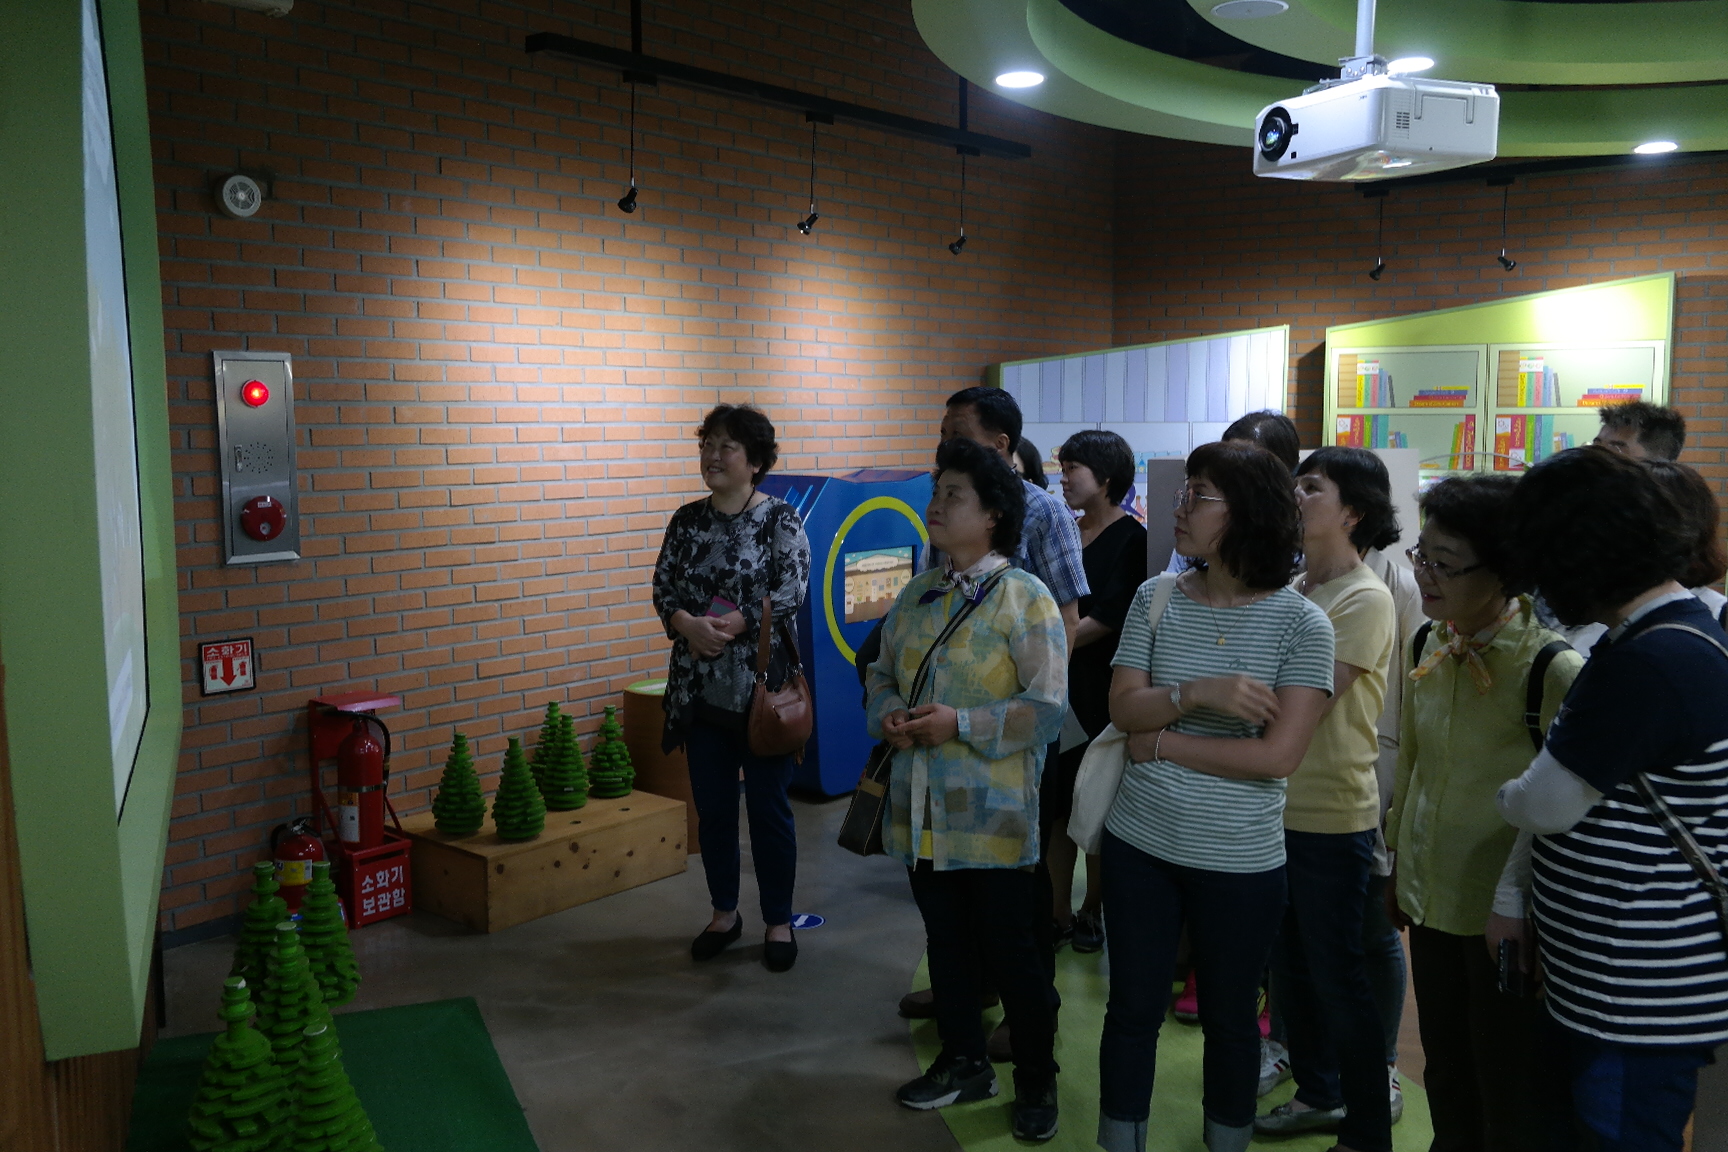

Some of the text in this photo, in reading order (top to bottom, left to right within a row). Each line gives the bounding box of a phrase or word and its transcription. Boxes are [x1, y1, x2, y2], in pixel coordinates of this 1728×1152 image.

[206, 643, 248, 657] 소화기
[361, 865, 404, 894] 소화기
[363, 887, 406, 917] 보관함
